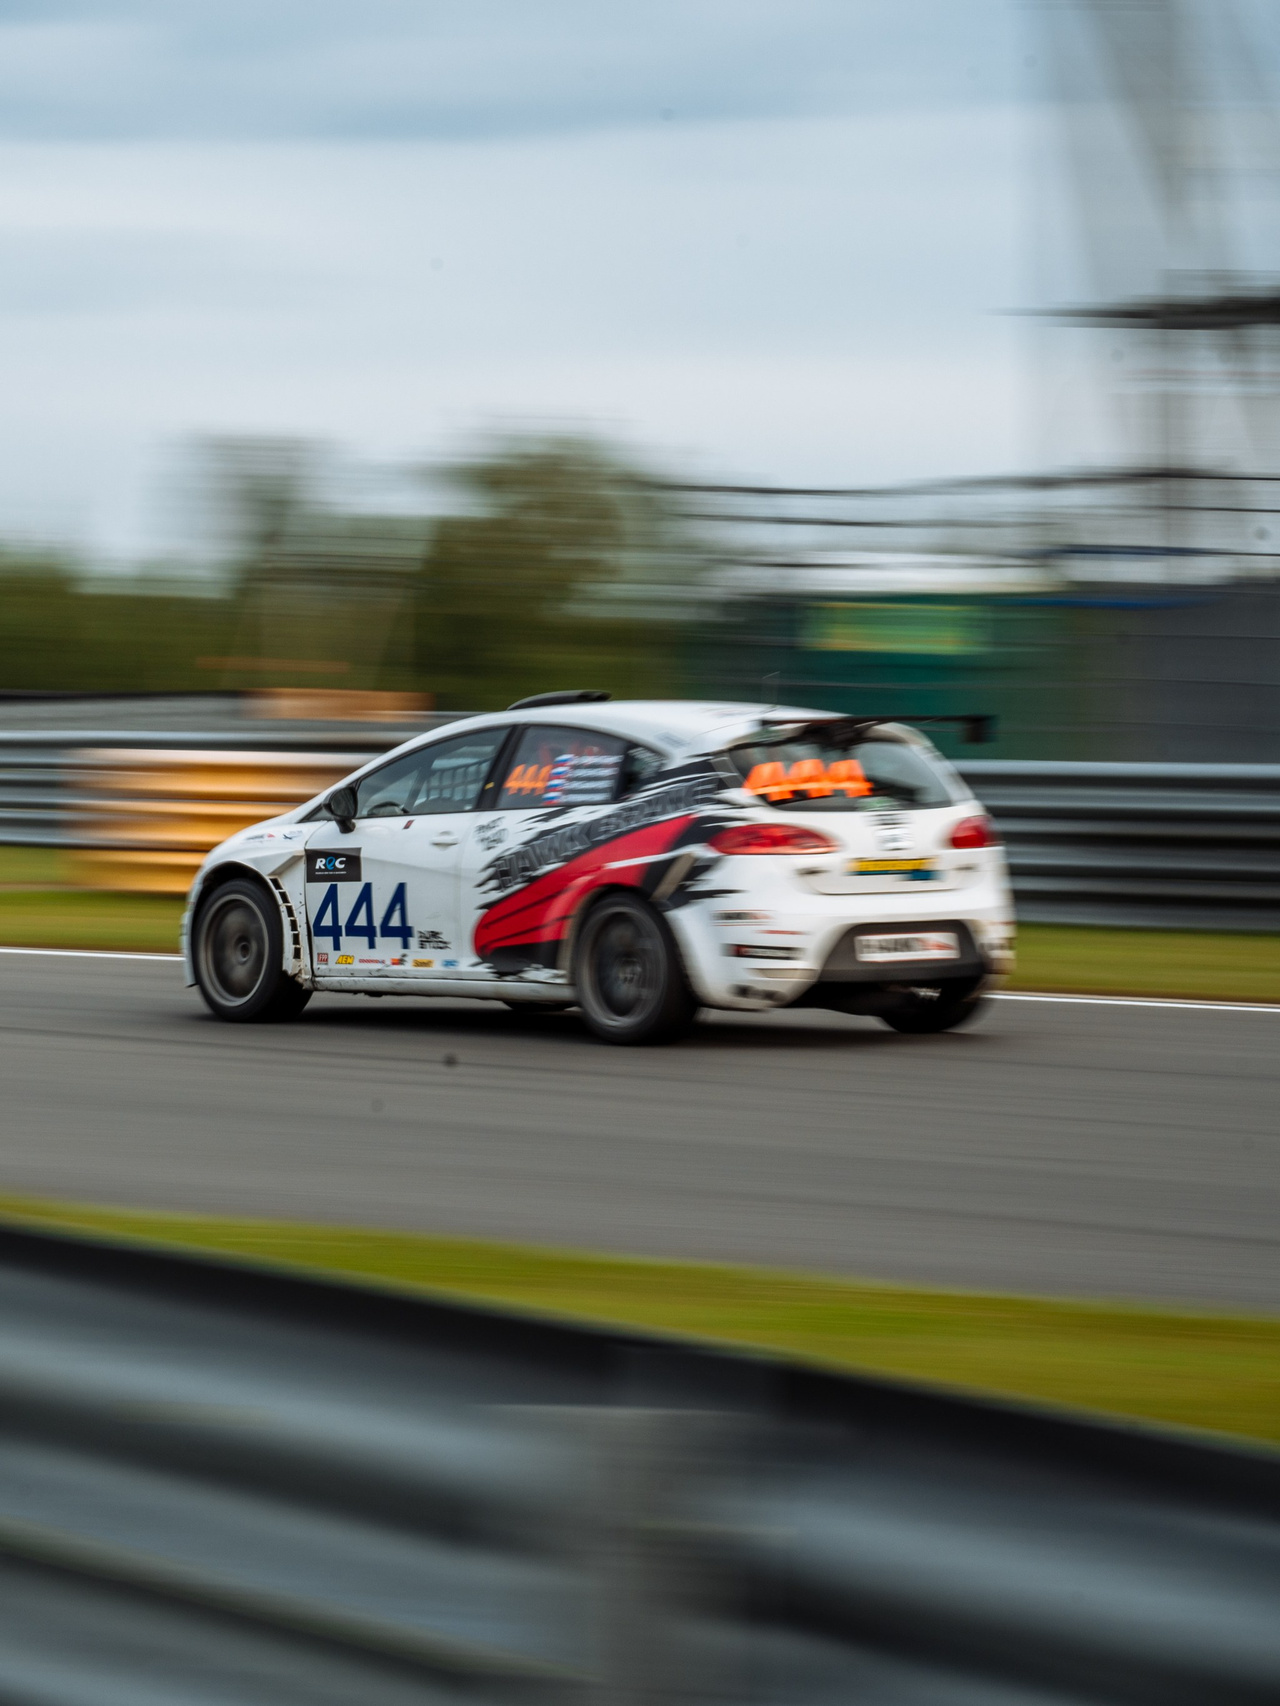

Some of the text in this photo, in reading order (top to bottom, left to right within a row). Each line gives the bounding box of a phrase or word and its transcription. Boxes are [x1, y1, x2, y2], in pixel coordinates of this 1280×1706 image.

[503, 764, 553, 796] 444
[492, 820, 594, 894] HAWK
[312, 882, 414, 952] 444
[335, 954, 355, 965] AEM
